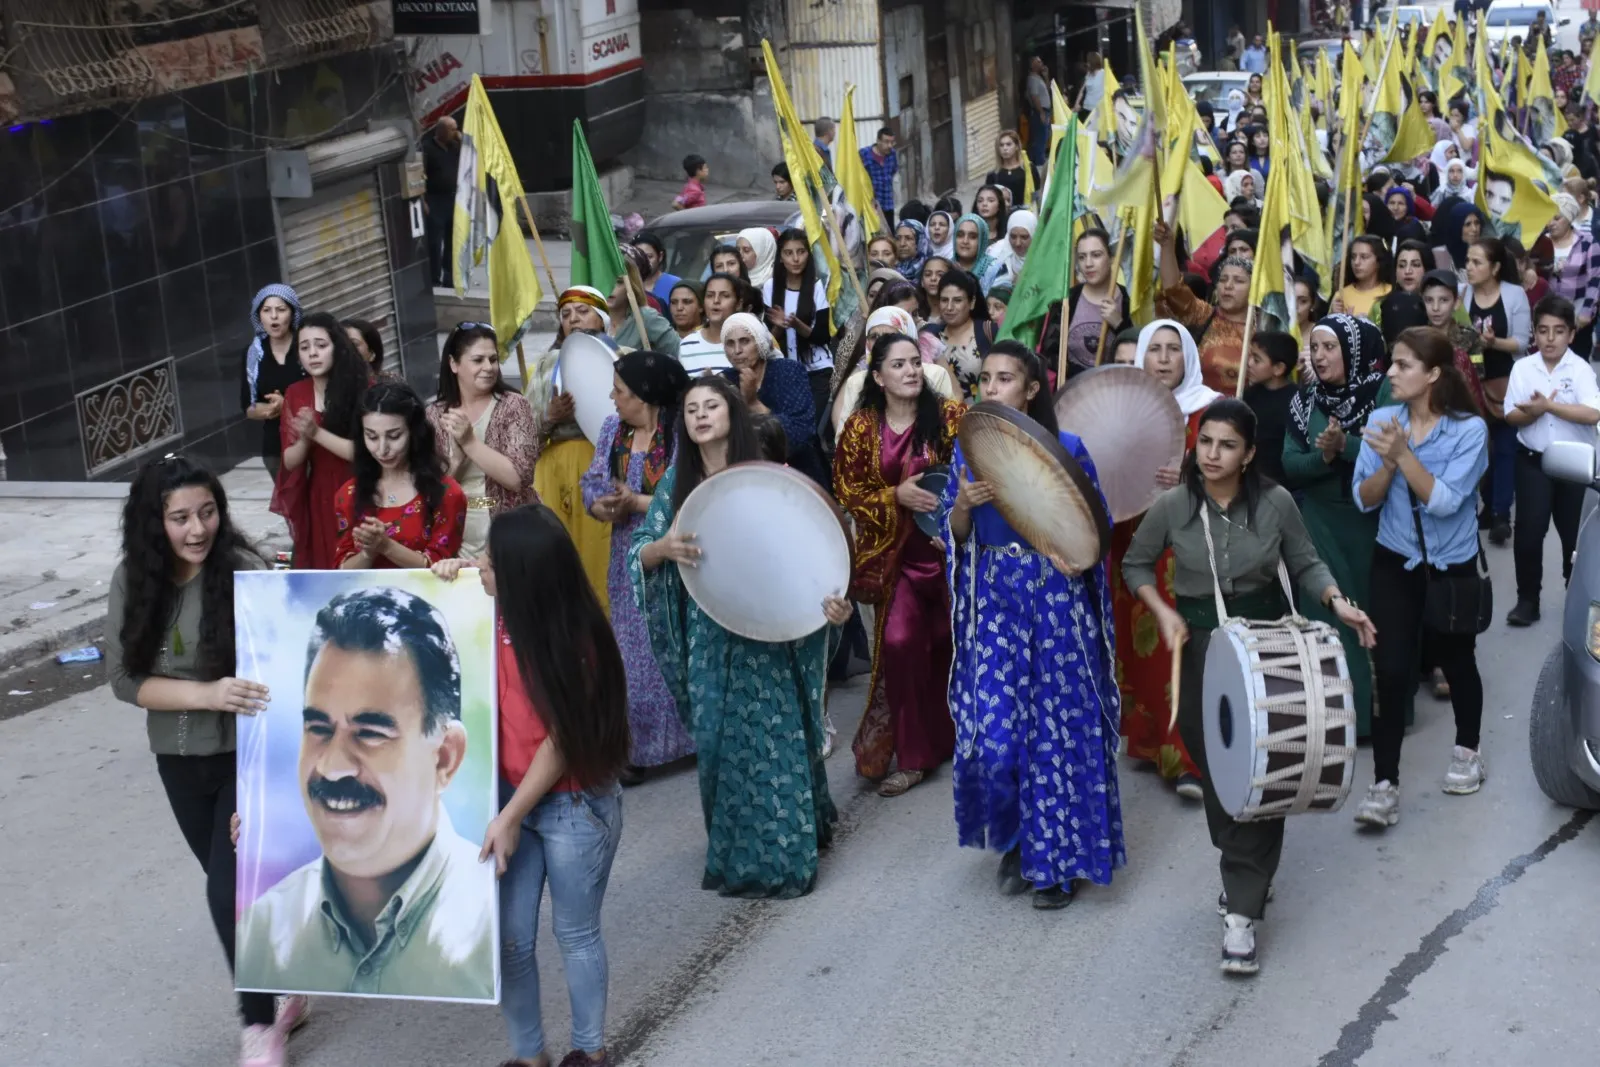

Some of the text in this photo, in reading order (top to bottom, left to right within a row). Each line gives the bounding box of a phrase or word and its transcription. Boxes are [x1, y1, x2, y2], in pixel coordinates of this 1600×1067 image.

[396, 2, 477, 12] ABOOD ROTANA
[592, 33, 630, 60] SCANIA
[412, 52, 463, 94] NIA
